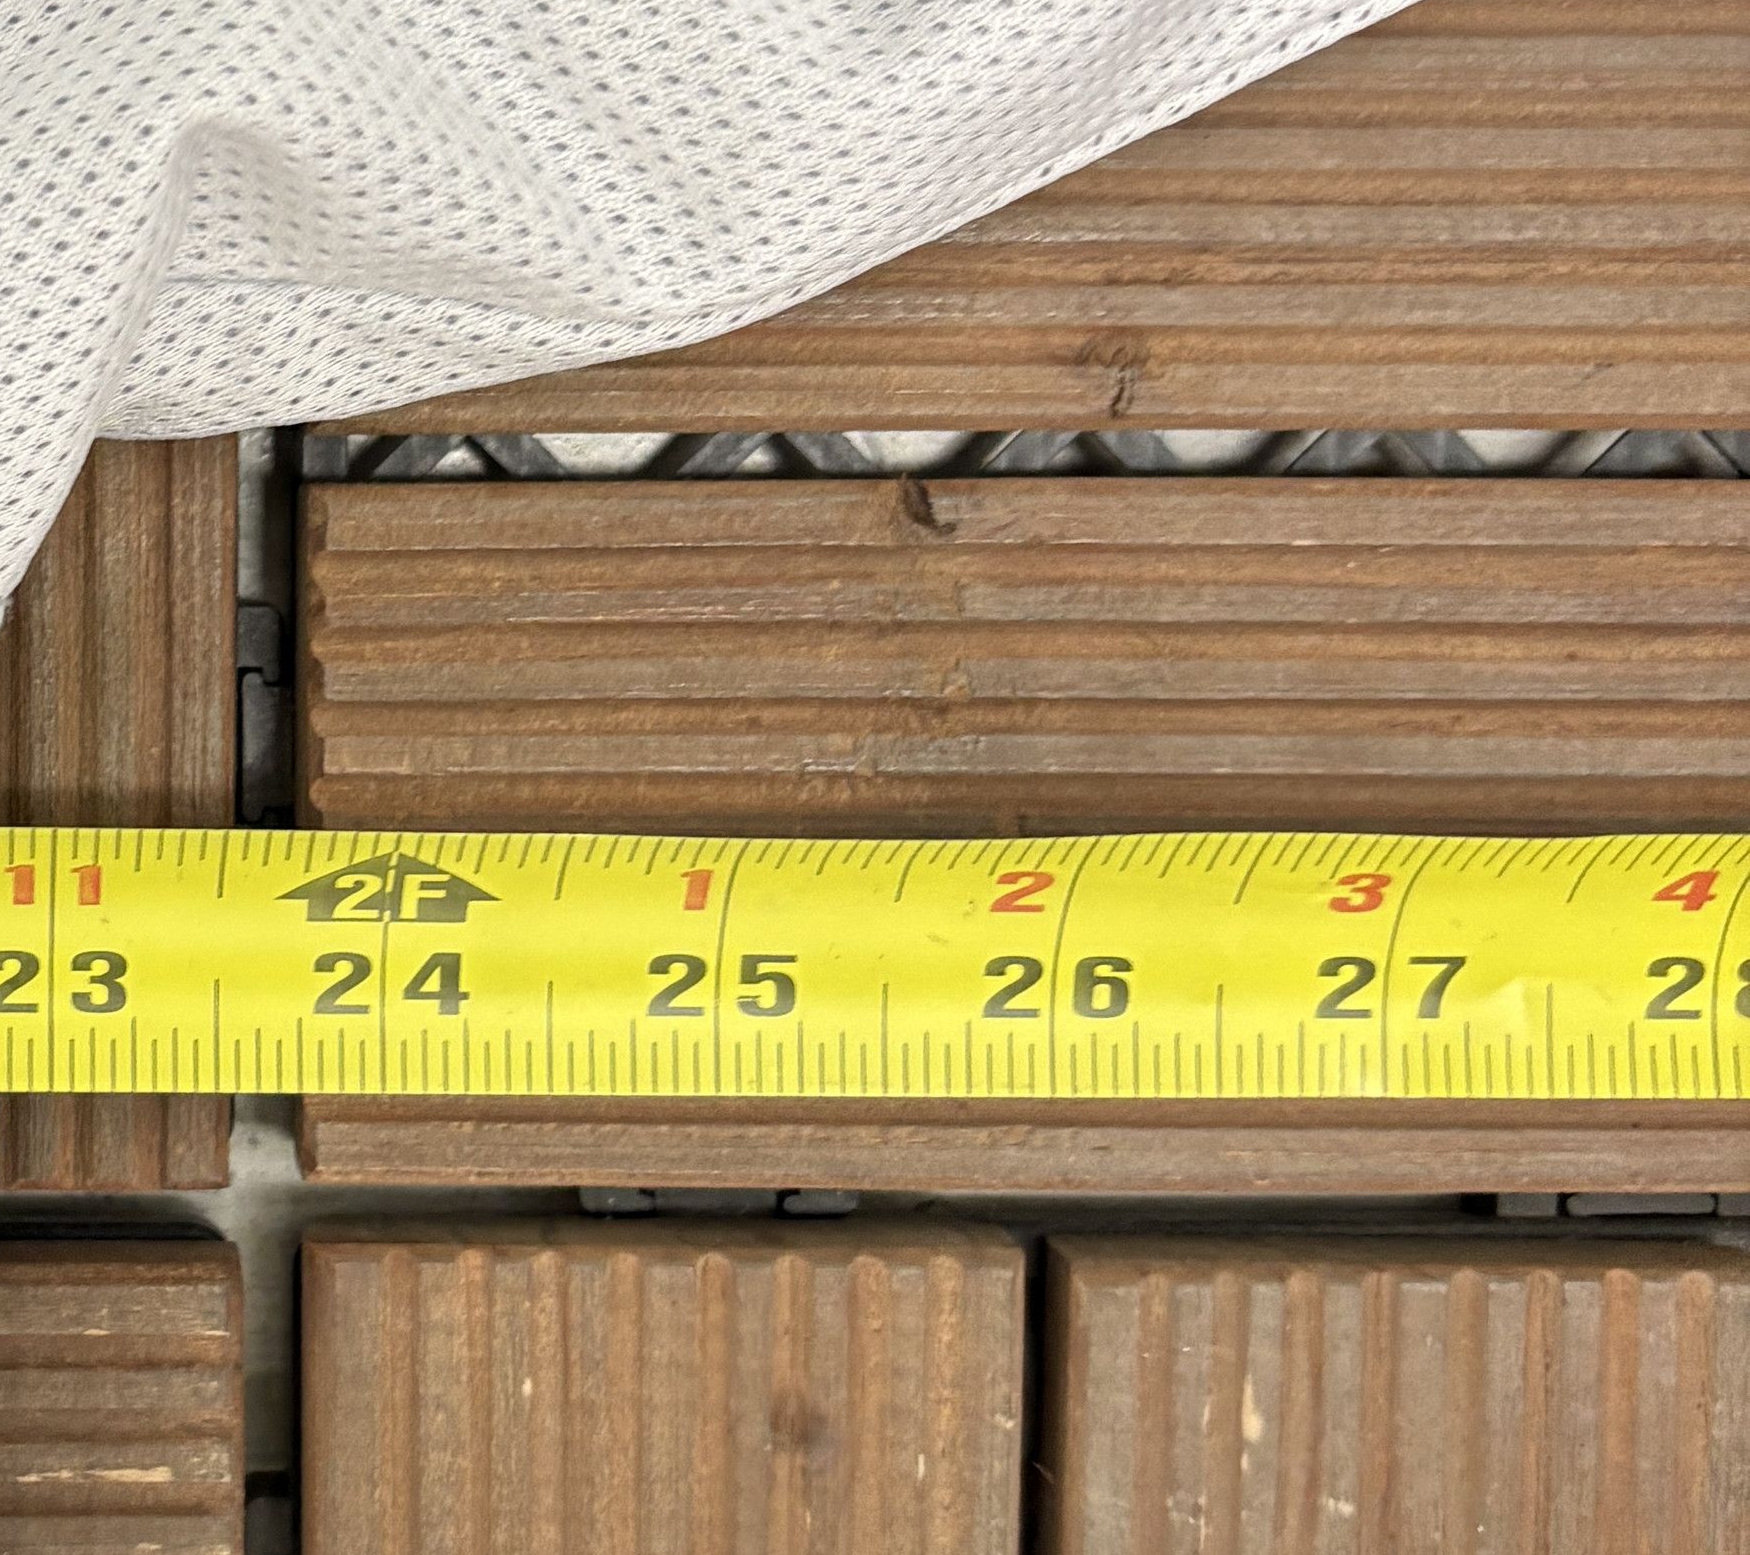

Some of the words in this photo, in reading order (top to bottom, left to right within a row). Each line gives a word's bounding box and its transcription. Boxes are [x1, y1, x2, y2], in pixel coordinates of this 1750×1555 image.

[6, 864, 102, 905] 11
[334, 873, 451, 920] 2F
[682, 869, 714, 910] 1
[990, 871, 1055, 912] 2
[1328, 873, 1393, 912] 3
[1652, 871, 1719, 911] 4
[313, 952, 470, 1016] 24
[648, 954, 797, 1017] 25
[981, 956, 1134, 1019] 26
[1316, 956, 1467, 1020] 27
[1645, 956, 1750, 1021] 2
